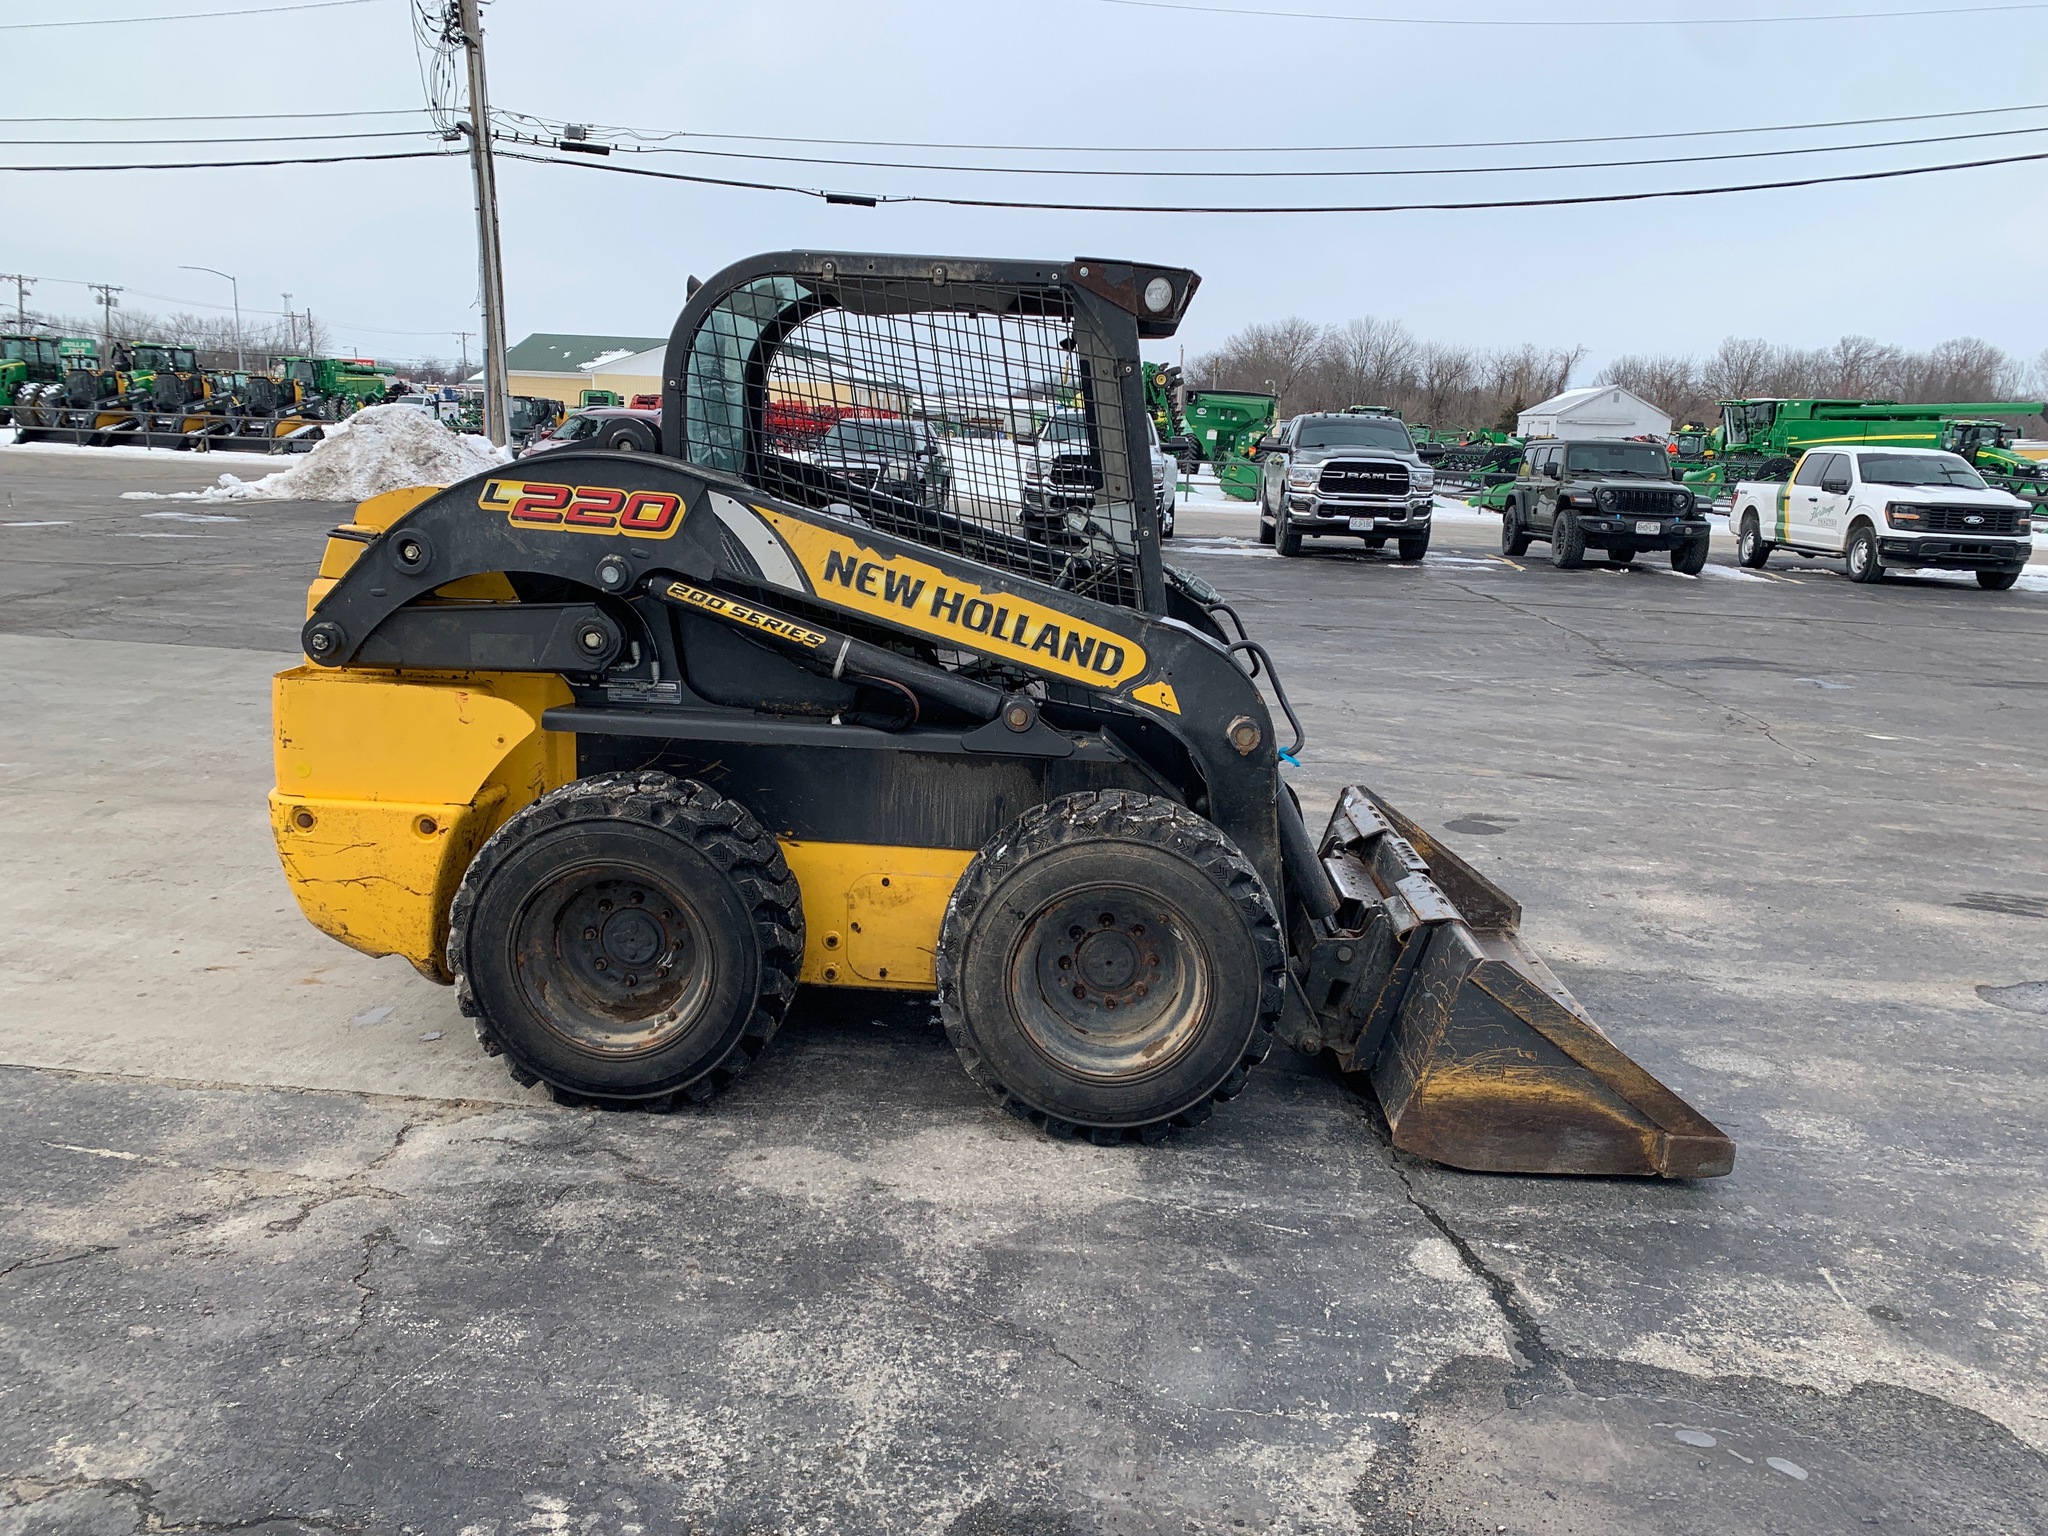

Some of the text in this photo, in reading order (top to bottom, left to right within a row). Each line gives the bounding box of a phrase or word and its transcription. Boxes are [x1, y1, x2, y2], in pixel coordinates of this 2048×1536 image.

[1708, 472, 1717, 481] 2
[669, 583, 824, 646] 200 SERIES
[823, 550, 1125, 677] NEW HOLLAND
